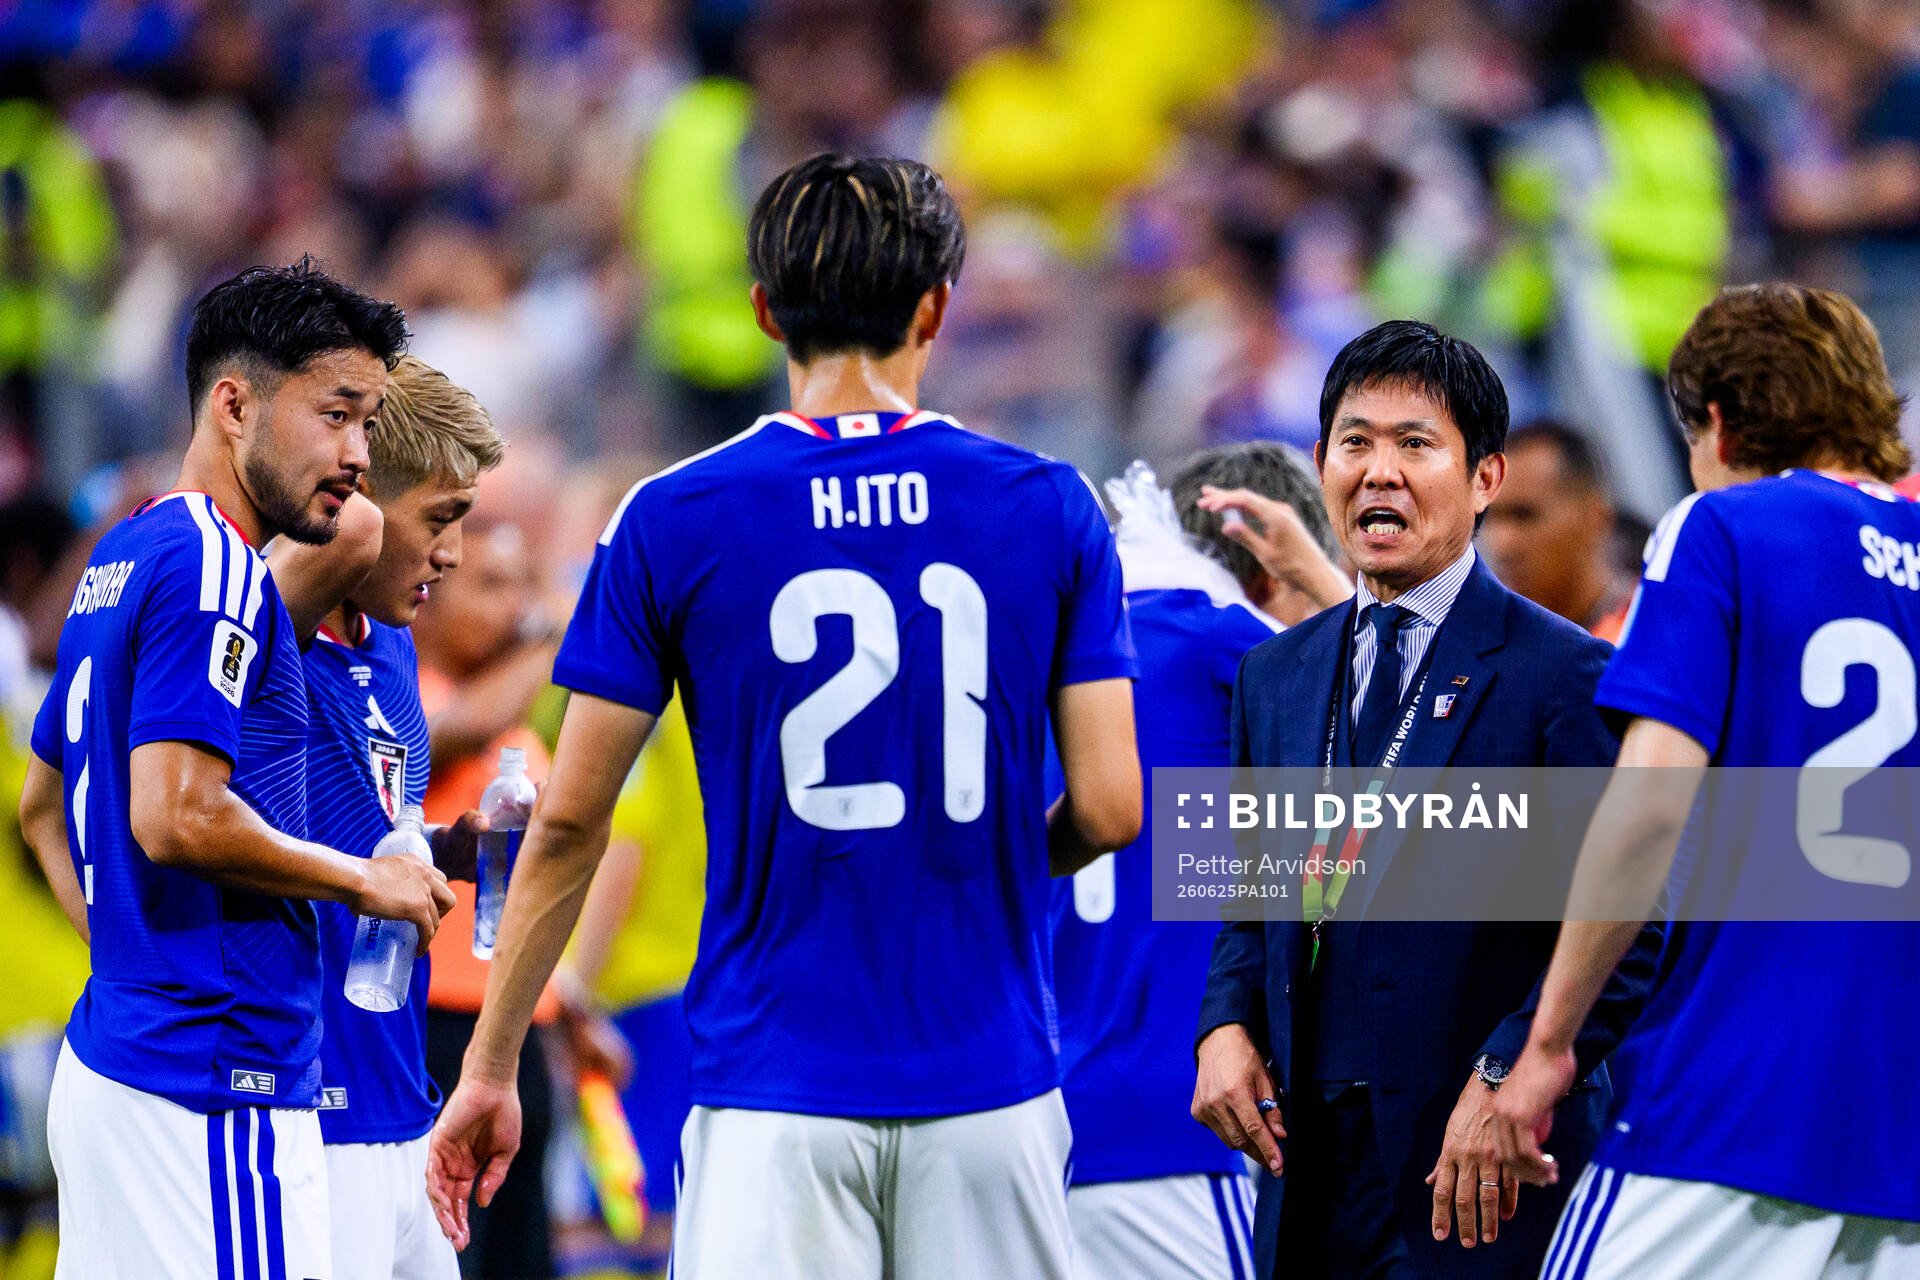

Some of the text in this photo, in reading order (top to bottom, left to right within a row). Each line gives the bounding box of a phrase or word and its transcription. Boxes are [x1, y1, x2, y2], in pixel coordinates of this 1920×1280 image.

[811, 471, 929, 529] H.ITO
[769, 562, 988, 831] 21
[1382, 741, 1403, 769] FIFA
[1797, 617, 1918, 889] 2
